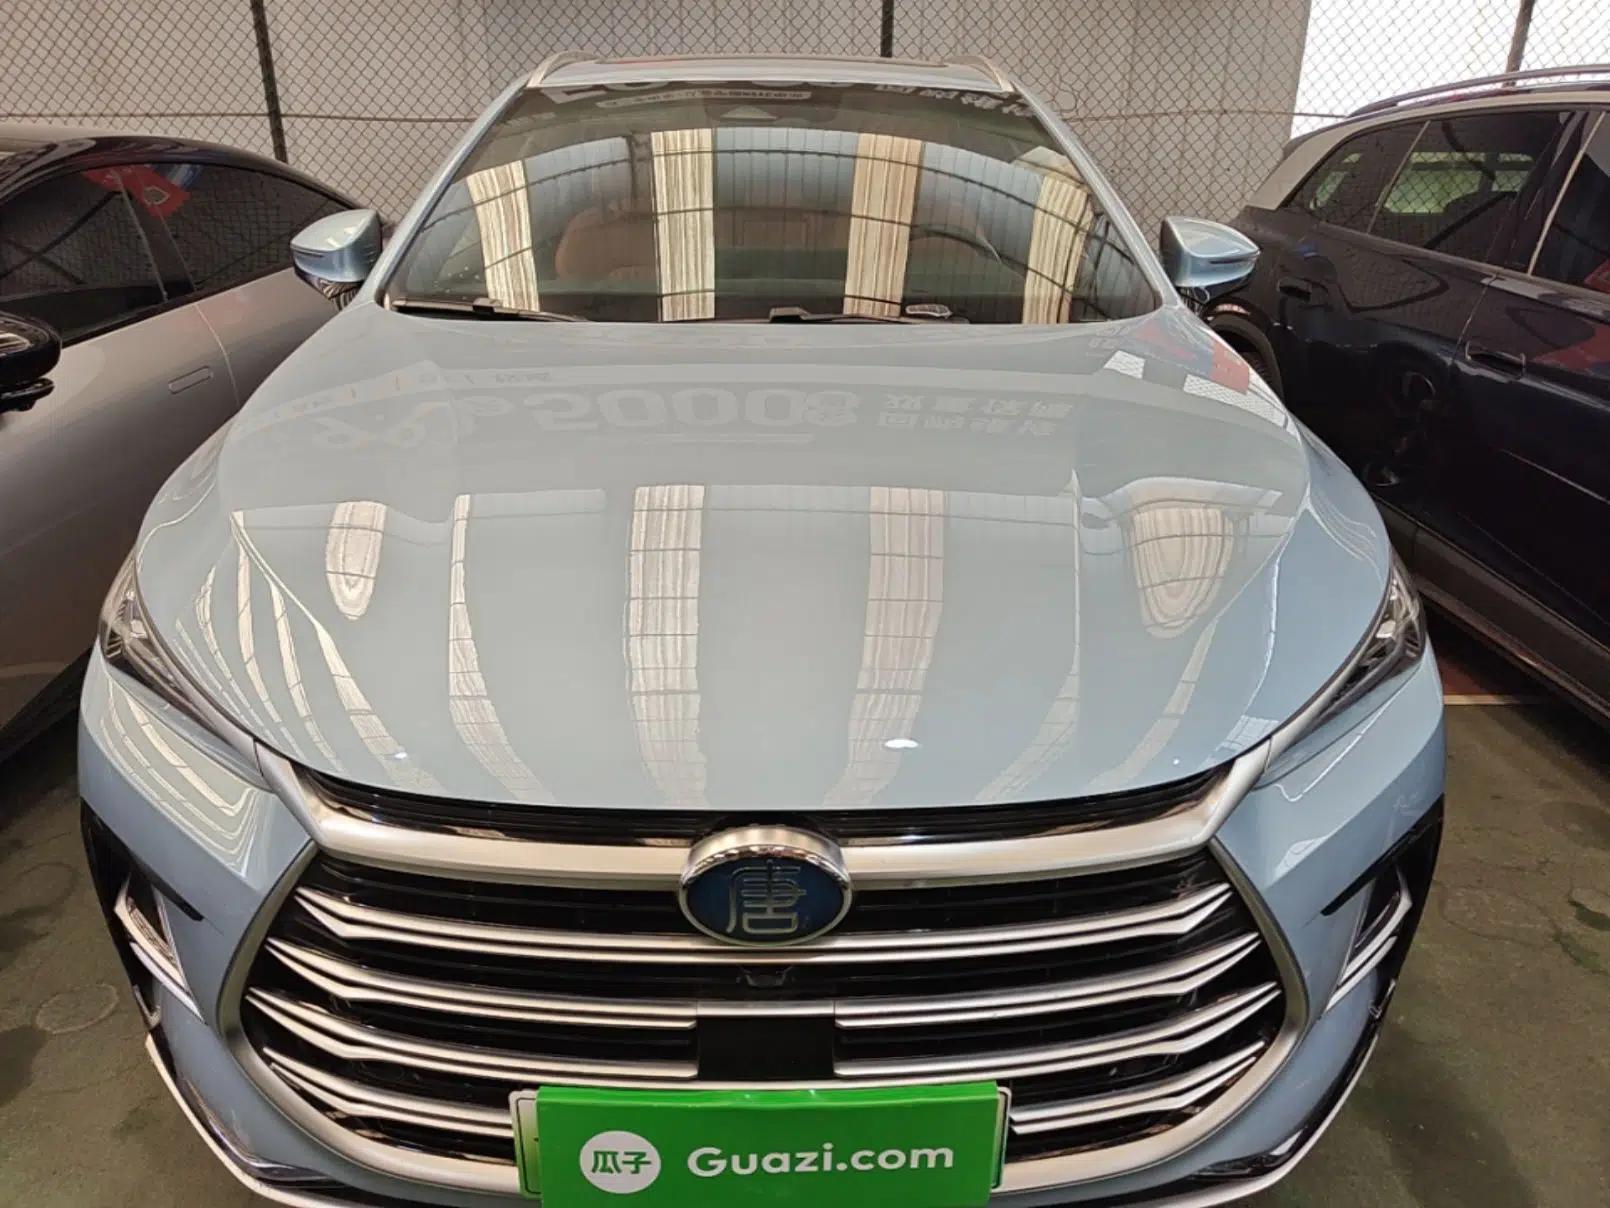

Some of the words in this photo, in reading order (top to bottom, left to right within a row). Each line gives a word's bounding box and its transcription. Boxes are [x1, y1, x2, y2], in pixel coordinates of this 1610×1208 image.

[726, 859, 807, 935] 唐
[590, 1150, 652, 1174] 瓜子
[686, 1142, 954, 1178] Guazi.com
